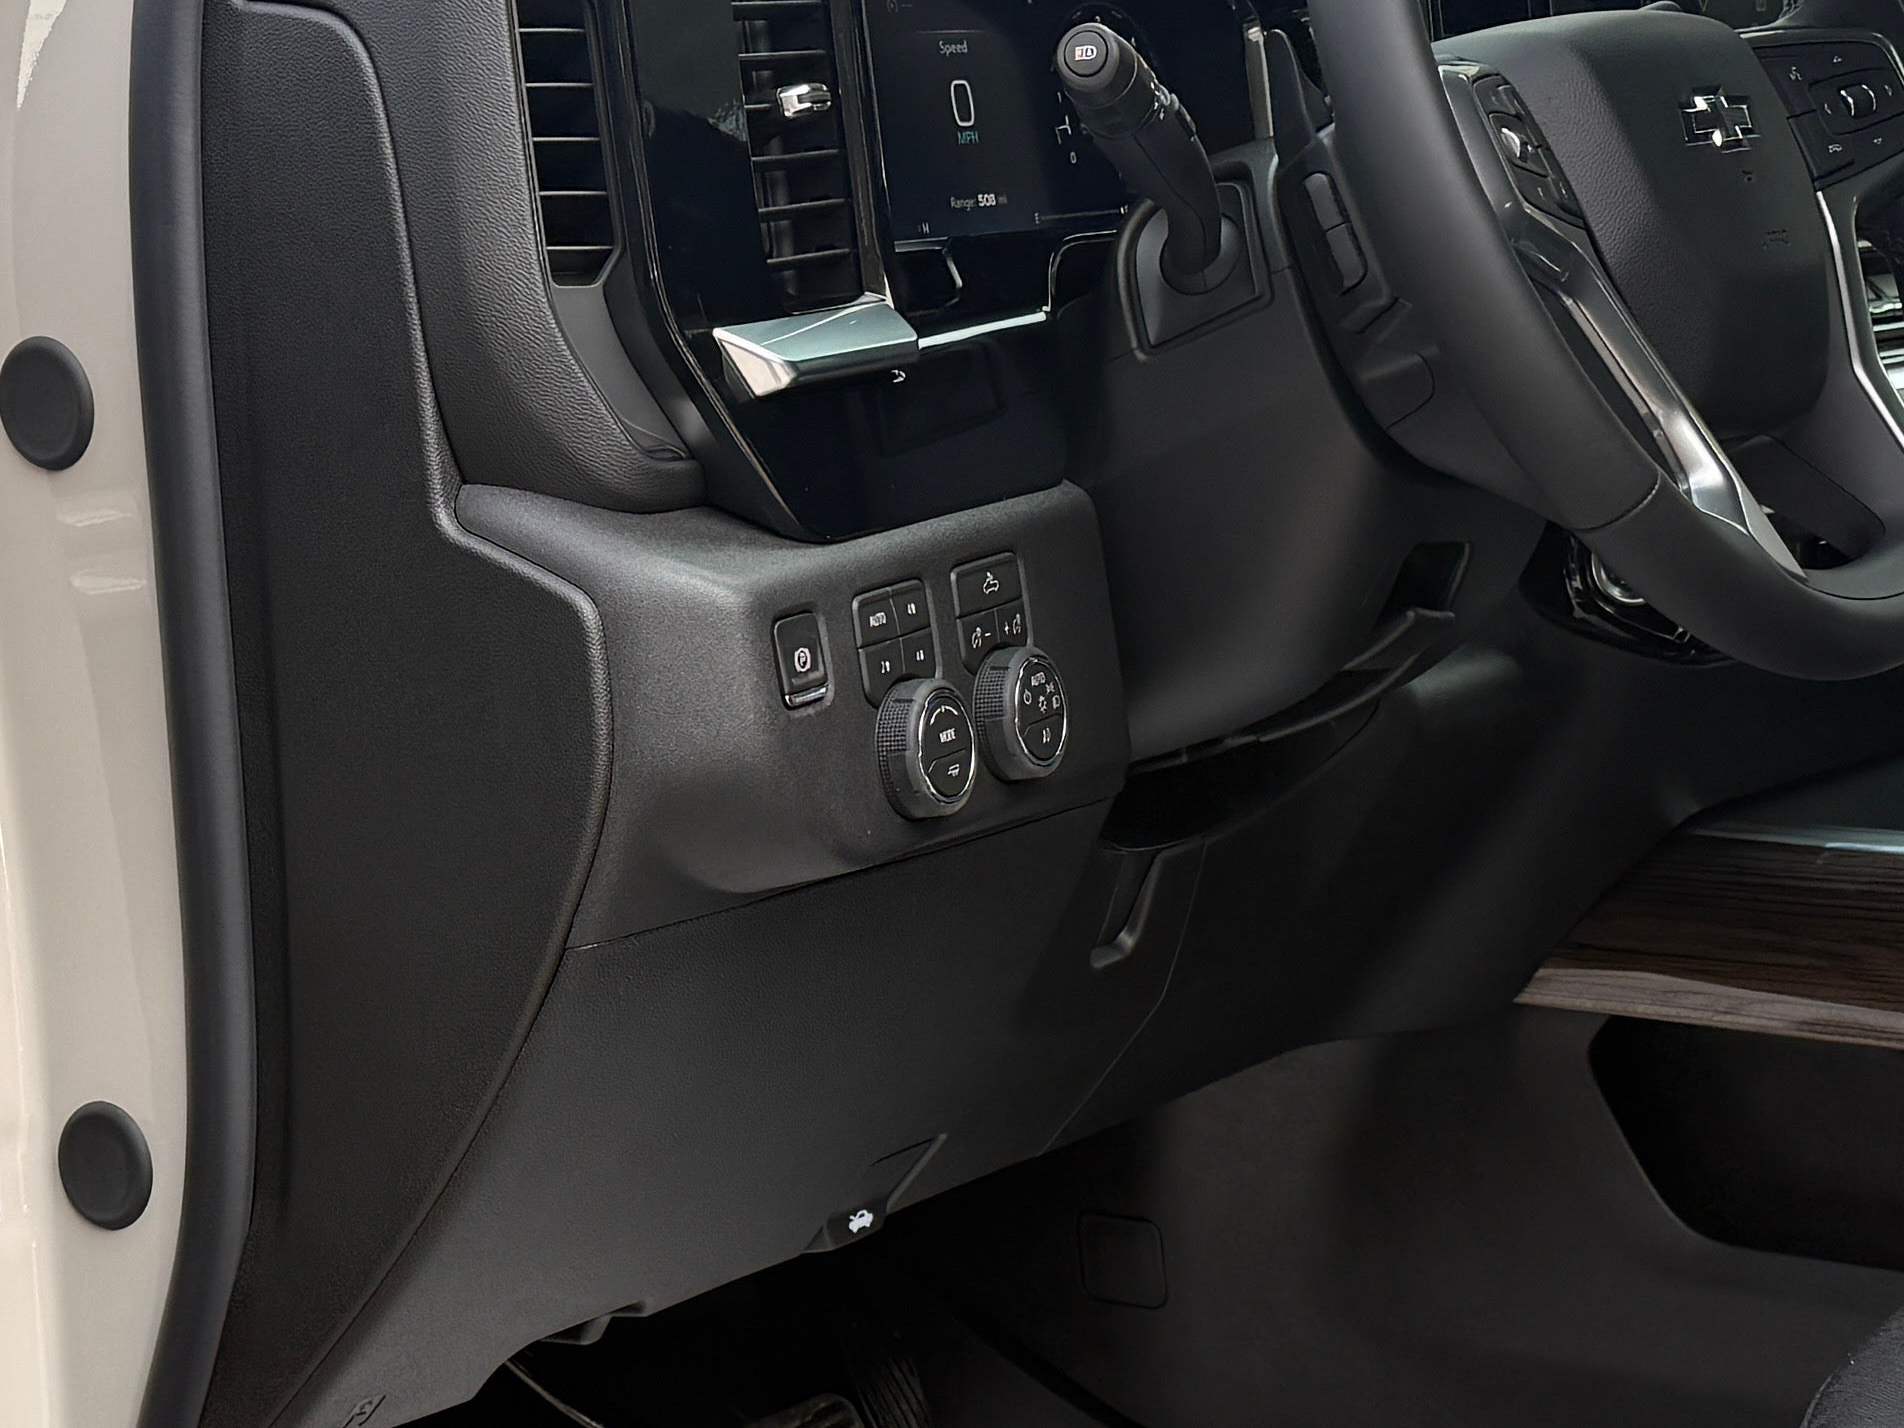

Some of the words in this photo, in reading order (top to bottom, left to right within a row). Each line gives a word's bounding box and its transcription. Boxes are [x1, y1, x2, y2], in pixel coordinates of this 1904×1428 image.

[939, 40, 968, 57] Speed
[950, 79, 975, 128] 0
[957, 131, 979, 146] MPH
[939, 727, 956, 743] MODE
